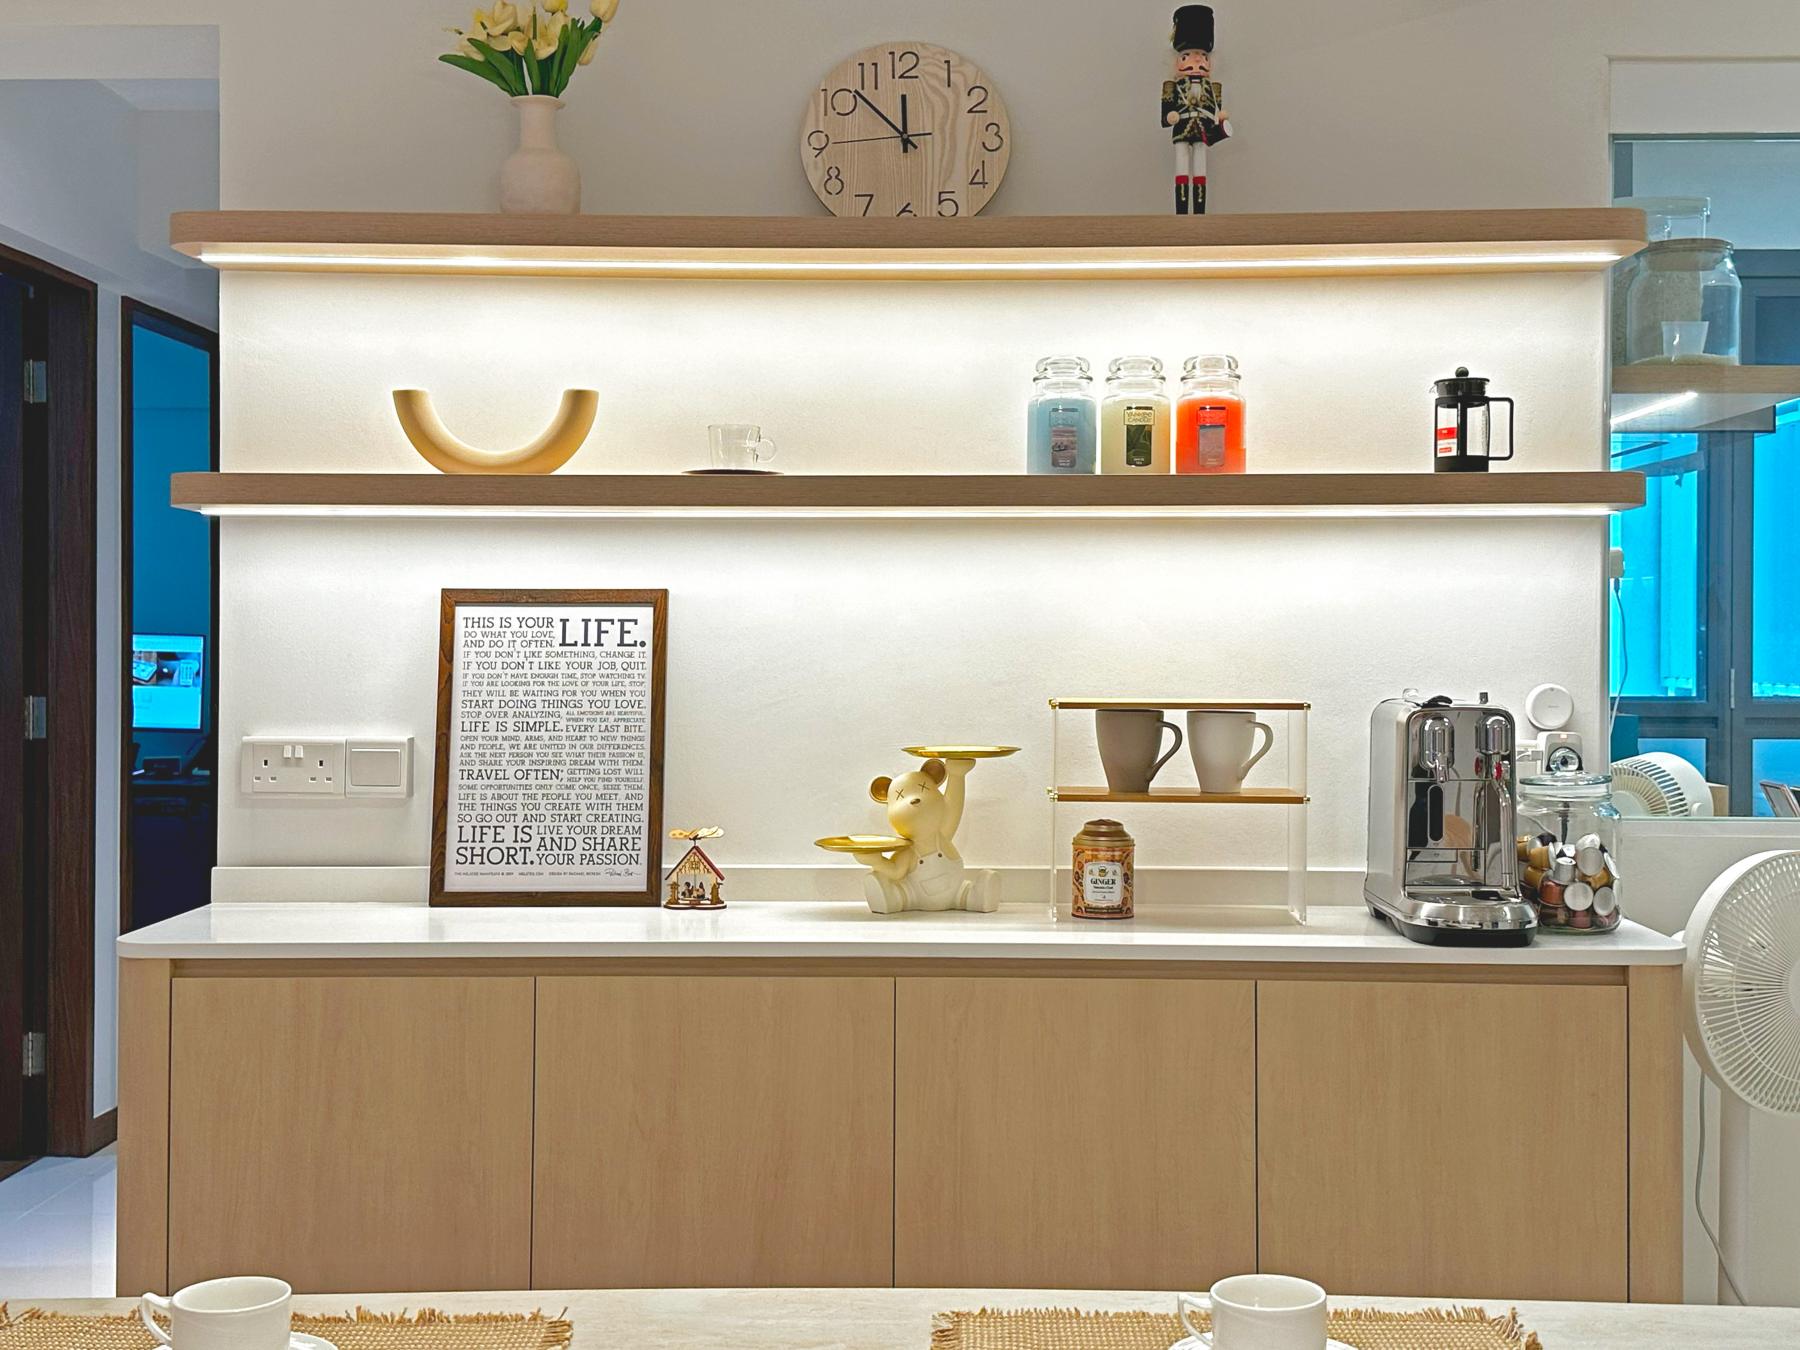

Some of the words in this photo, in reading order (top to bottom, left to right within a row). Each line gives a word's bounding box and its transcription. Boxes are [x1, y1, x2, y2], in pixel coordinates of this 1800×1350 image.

[889, 51, 920, 79] 12
[944, 60, 951, 87] 1
[858, 63, 878, 90] 11
[821, 88, 857, 116] 10
[967, 86, 988, 113] 2
[807, 130, 829, 158] 9
[982, 123, 1003, 152] 3
[824, 166, 844, 195] 8
[969, 160, 988, 189] 4
[854, 194, 874, 216] 7
[938, 191, 959, 216] 5
[463, 617, 494, 629] THIS
[500, 617, 511, 629] IS
[517, 617, 554, 629] YOUR
[559, 618, 646, 647] LIFE.
[463, 640, 484, 648] AND
[489, 640, 504, 648] DO
[508, 640, 517, 648] IT
[495, 649, 521, 658] DON'T
[463, 661, 472, 670] IF
[476, 661, 497, 670] YOU
[501, 659, 534, 670] DON'T
[538, 661, 561, 670] LIKE
[566, 661, 593, 670] YOUR
[462, 700, 494, 709] START
[498, 700, 536, 709] DOING
[541, 700, 583, 709] THINGS
[588, 700, 610, 709] YOU
[461, 711, 482, 719] STOP
[485, 711, 508, 719] OVER
[461, 721, 490, 732] LIFE
[496, 721, 507, 732] IS
[513, 721, 563, 732] SIMPLE.
[459, 769, 510, 781] TRAVEL
[514, 769, 564, 781] OFTEN;
[458, 803, 477, 811] THE
[480, 803, 517, 811] THINGS
[521, 803, 541, 811] YOU
[544, 803, 581, 811] CREATE
[585, 803, 612, 811] WITH
[616, 803, 643, 811] THEM
[457, 814, 472, 823] SO
[475, 814, 492, 823] GO
[496, 814, 518, 823] OUT
[522, 814, 546, 823] AND
[550, 814, 582, 823] START
[458, 825, 505, 843] LIFE
[513, 825, 532, 843] IS
[537, 826, 563, 835] LIVE
[566, 826, 597, 835] YOUR
[601, 826, 642, 835] DREAM
[536, 837, 576, 852] AND
[582, 837, 641, 852] SHARE
[456, 847, 534, 865] SHORT.
[536, 854, 575, 865] YOUR
